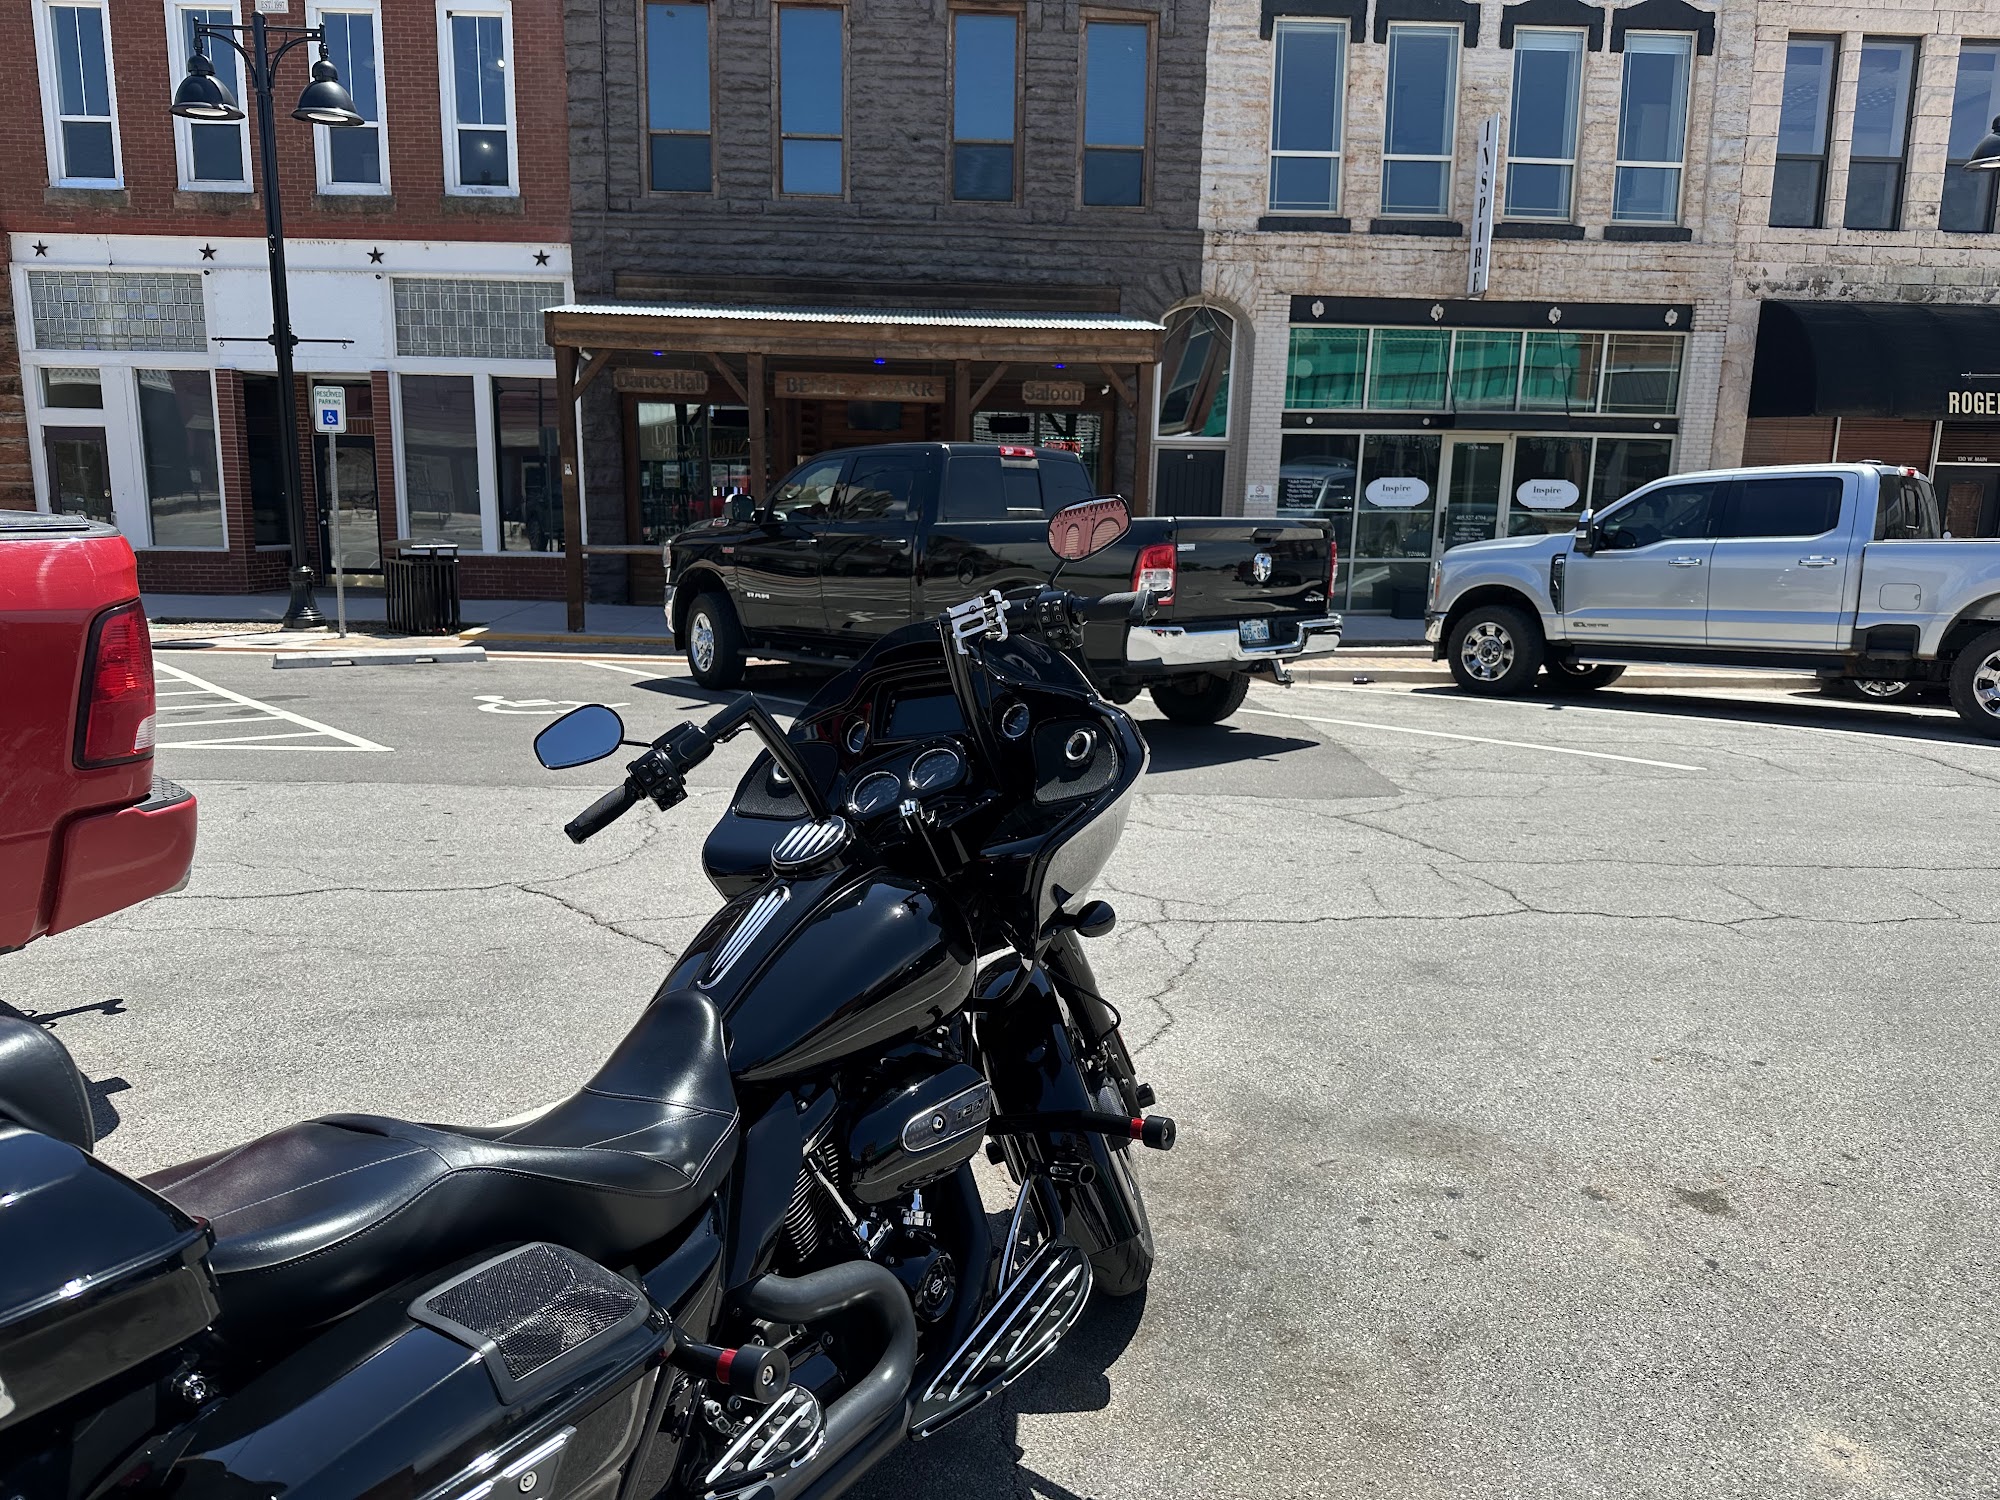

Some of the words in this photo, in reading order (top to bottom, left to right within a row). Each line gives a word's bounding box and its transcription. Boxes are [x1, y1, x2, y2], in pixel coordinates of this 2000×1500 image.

[1472, 120, 1491, 293] INSPIRE
[617, 372, 672, 389] Dance
[673, 372, 706, 390] Hall
[785, 376, 847, 395] BELLE
[866, 379, 936, 397] STARR
[316, 390, 343, 398] RESERVED
[1024, 384, 1083, 401] Saloon
[1948, 391, 2000, 415] ROGE
[1382, 484, 1411, 494] Inspire
[1533, 486, 1562, 496] Inspire
[746, 592, 770, 600] RAM
